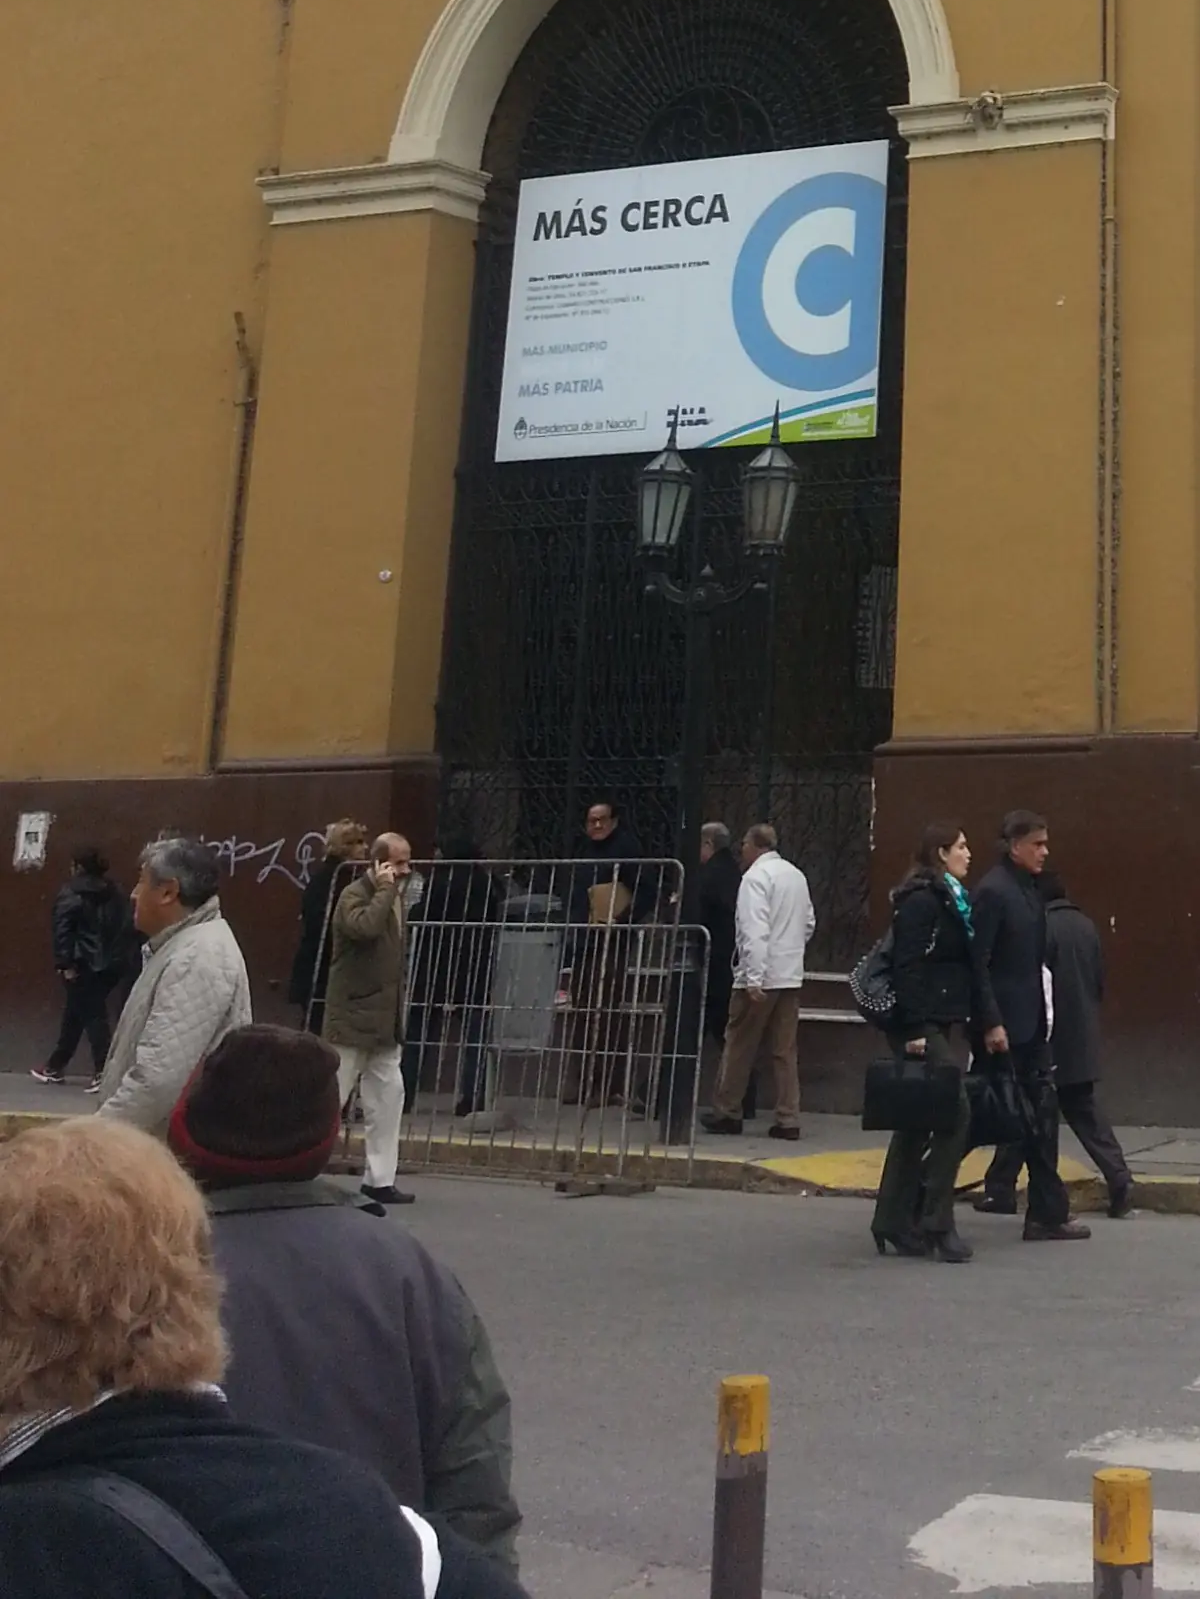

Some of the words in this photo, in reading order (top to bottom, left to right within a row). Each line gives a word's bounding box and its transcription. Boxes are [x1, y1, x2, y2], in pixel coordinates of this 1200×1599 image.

[533, 198, 608, 241] MÁS
[620, 193, 730, 233] CERCA
[548, 340, 608, 355] MUNICIPIO
[555, 378, 604, 394] PATRIA
[529, 423, 579, 434] Presidencia
[581, 420, 593, 431] de
